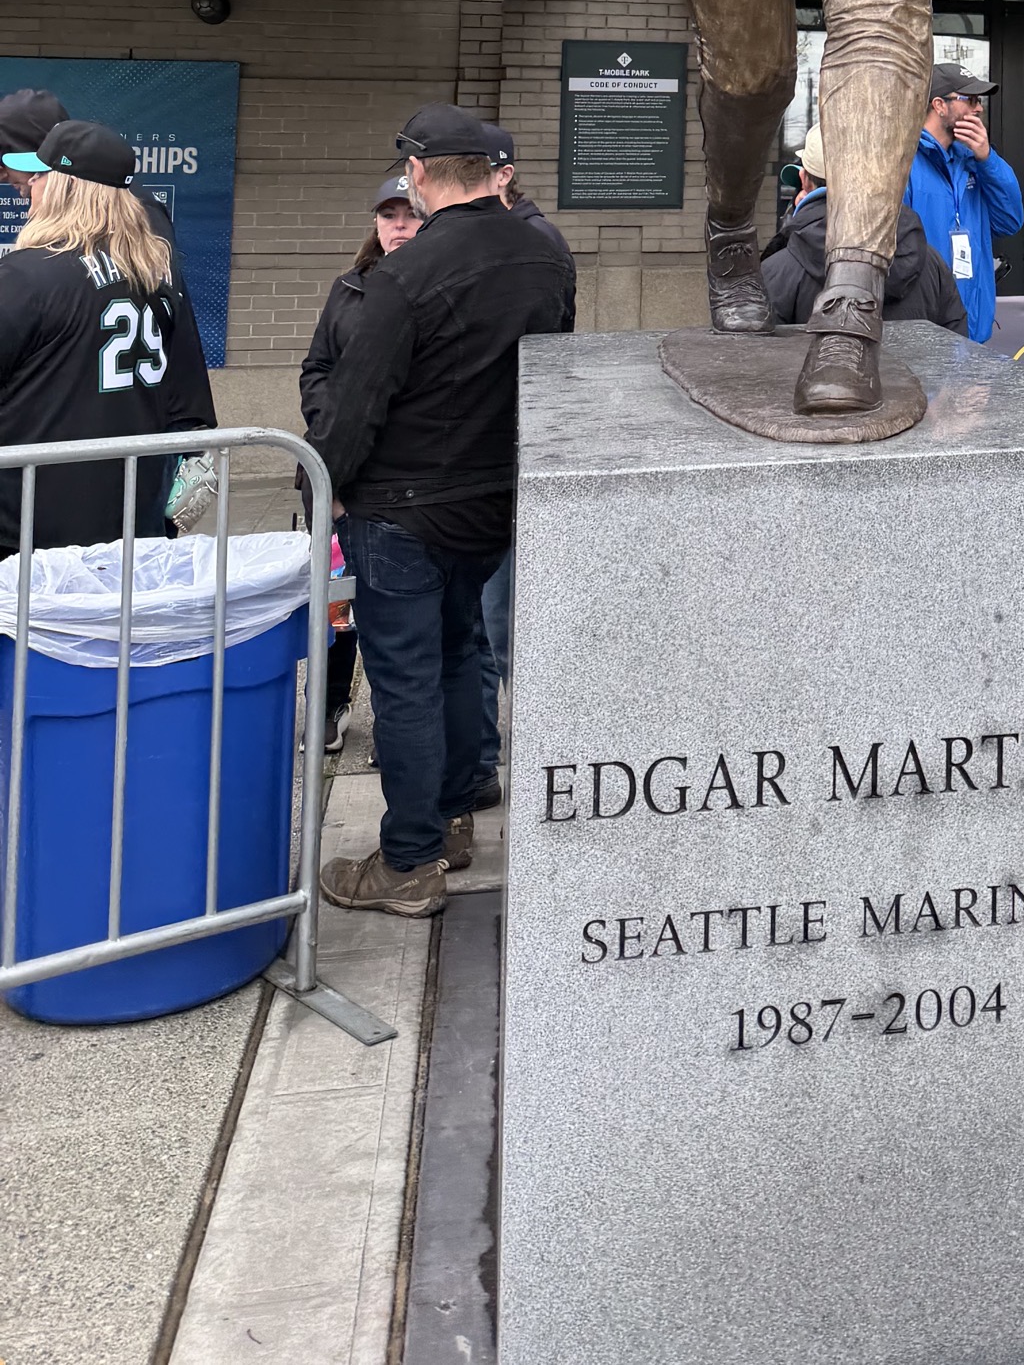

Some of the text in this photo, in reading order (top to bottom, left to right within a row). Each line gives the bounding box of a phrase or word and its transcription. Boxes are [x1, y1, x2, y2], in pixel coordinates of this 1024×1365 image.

[12, 198, 30, 206] YOUR
[99, 298, 173, 393] 29
[541, 748, 791, 824] EDGAR
[581, 900, 828, 964] SEATTLE
[729, 981, 1008, 1052] 1987-2004
